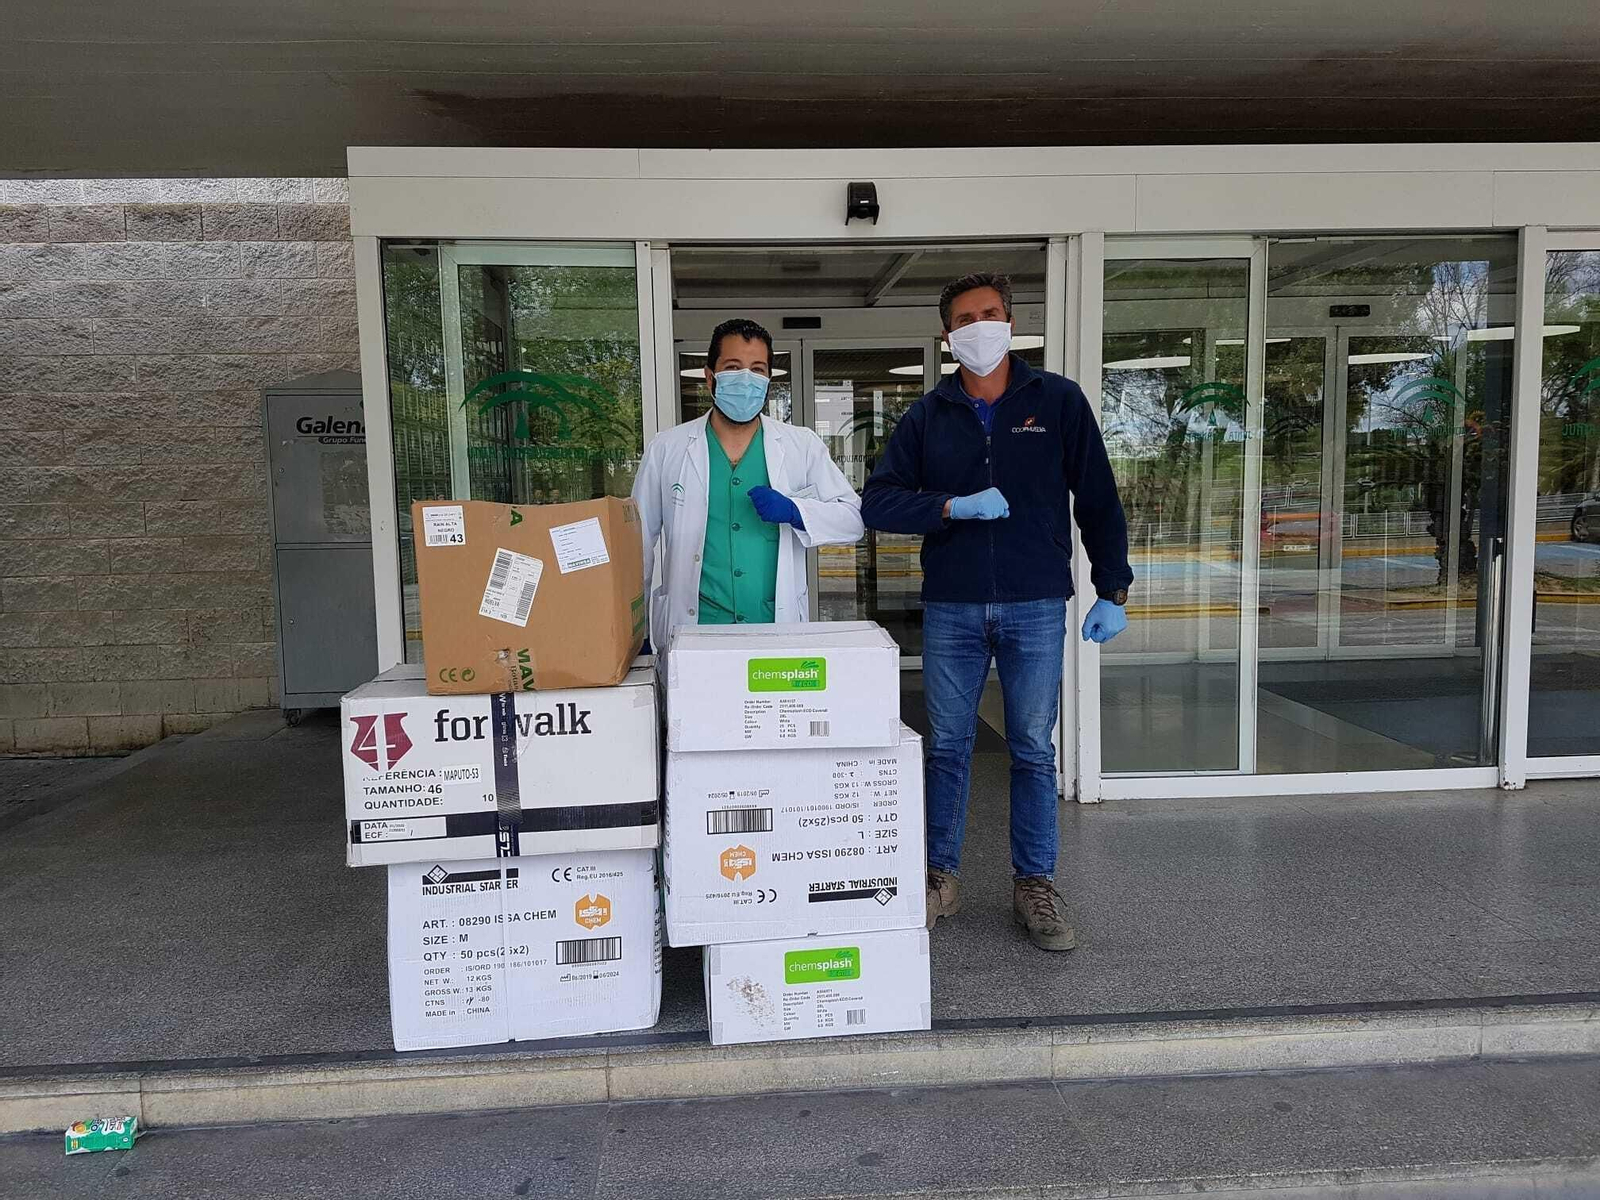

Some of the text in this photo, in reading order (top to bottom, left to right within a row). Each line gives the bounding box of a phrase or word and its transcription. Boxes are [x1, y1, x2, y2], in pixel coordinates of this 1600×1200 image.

[349, 436, 366, 444] Fun
[450, 533, 464, 543] 43
[752, 668, 818, 682] chemsplash
[434, 709, 488, 742] for
[836, 760, 859, 768] CHINA
[362, 768, 436, 782] ERÊNCIA
[443, 768, 479, 781] MAPUTO-S3
[363, 784, 443, 796] TAMANHO: 46
[834, 782, 850, 790] KGS
[364, 793, 494, 810] QUANTIDADE: 10
[835, 802, 859, 810] IS/ORD
[798, 814, 849, 828] pcs(25x2)
[852, 814, 864, 824] 50
[876, 812, 898, 823] QTY
[364, 822, 388, 830] DATA
[365, 831, 383, 839] ECF
[858, 831, 865, 840] L
[875, 828, 898, 839] SIZE
[806, 849, 832, 860] ISSA
[834, 846, 865, 857] 08290
[874, 844, 898, 855] ART.
[772, 851, 804, 862] CHEM
[422, 880, 519, 896] INDUSTRIAL STARER
[808, 876, 898, 892] INDUSTRIAL STARTER
[423, 919, 448, 930] ART.
[459, 916, 491, 927] 08290
[524, 909, 557, 921] CHEM
[423, 936, 448, 946] SIZE
[459, 933, 469, 943] M
[423, 951, 447, 962] QTY
[460, 950, 473, 960] 50
[424, 967, 450, 976] ORDER
[465, 964, 491, 972] IS/ORD
[789, 958, 852, 972] chemsplash
[476, 974, 492, 982] KGS
[424, 988, 451, 997] GROSS
[425, 1010, 447, 1018] MADE
[466, 1006, 491, 1015] CHINA
